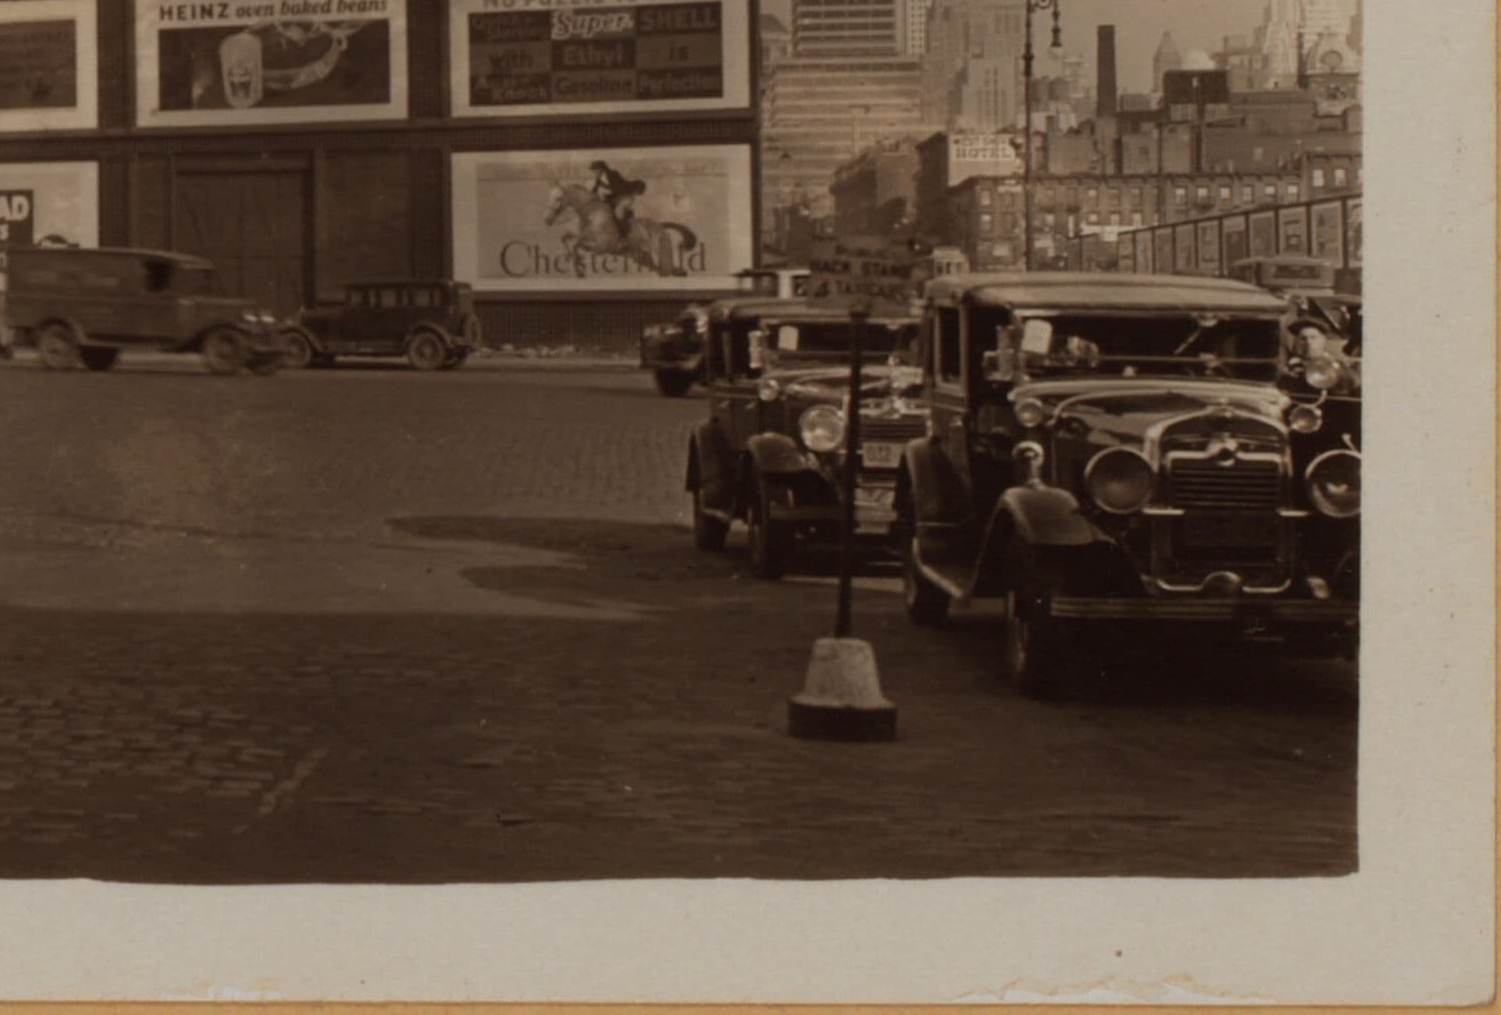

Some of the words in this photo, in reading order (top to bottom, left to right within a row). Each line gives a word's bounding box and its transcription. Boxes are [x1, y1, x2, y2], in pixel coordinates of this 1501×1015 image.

[159, 2, 230, 21] HEINZ
[235, 2, 274, 19] oven
[551, 10, 634, 40] Super
[642, 7, 717, 31] SHELL
